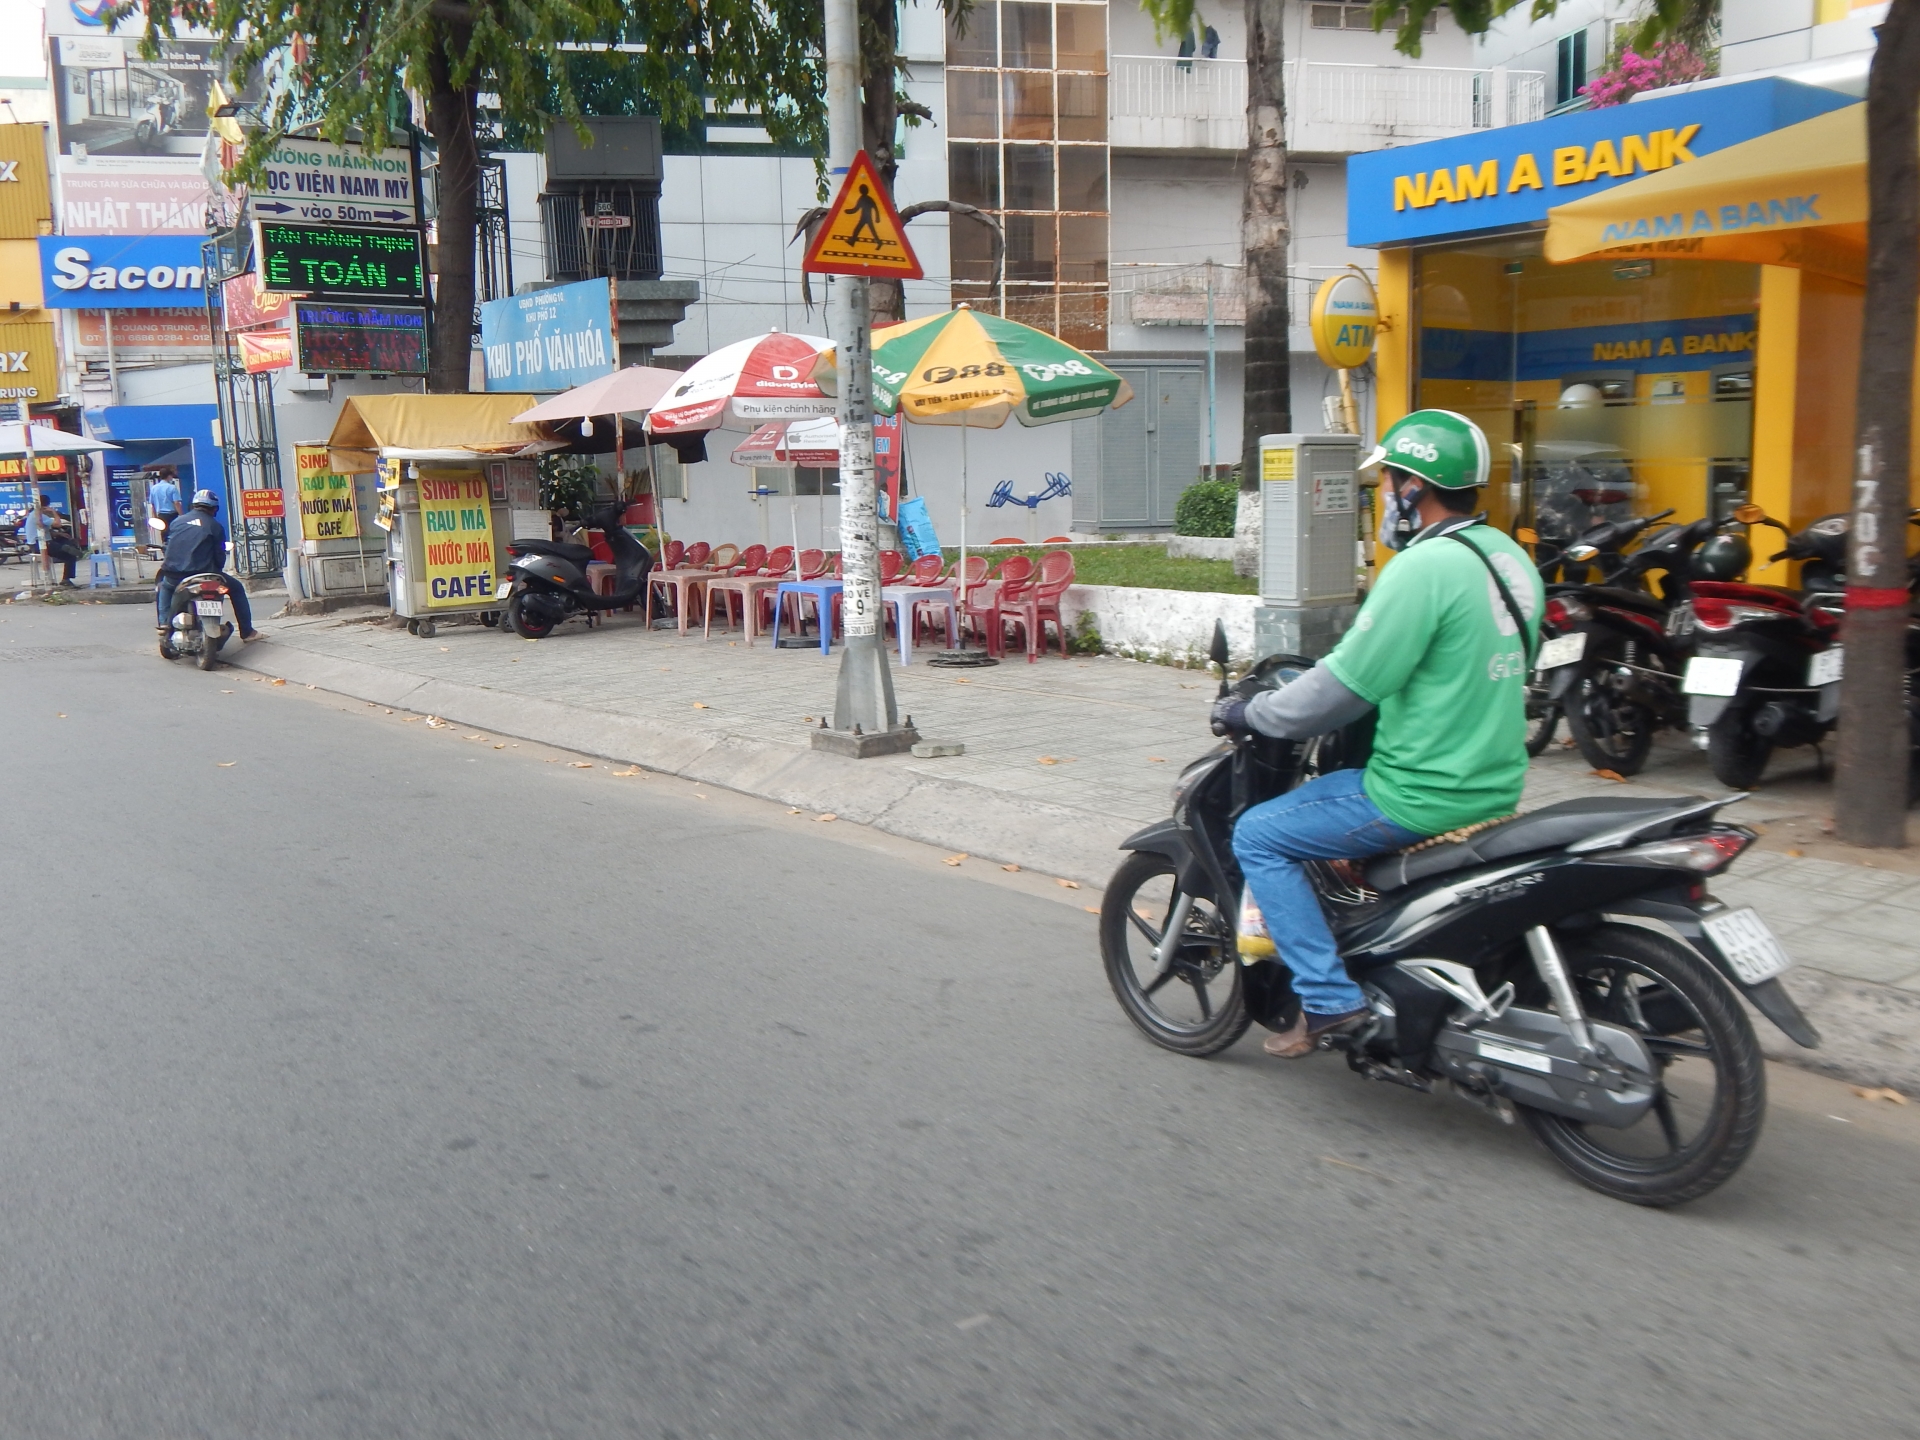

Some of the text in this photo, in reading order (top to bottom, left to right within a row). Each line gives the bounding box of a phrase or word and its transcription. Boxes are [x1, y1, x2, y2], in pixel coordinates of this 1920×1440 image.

[372, 159, 407, 174] NON
[1394, 124, 1703, 211] NAM A BANK
[66, 180, 98, 188] TRUNG
[99, 178, 119, 189] TÂM
[267, 170, 409, 199] ỌC VIỆN NAM MỸ
[300, 202, 372, 221] vào 50m
[1602, 194, 1822, 243] NAM A BANK
[266, 226, 415, 253] TÂN THÀNH THỊNH
[300, 307, 355, 325] TRƯỜNG
[394, 314, 423, 327] NON
[550, 307, 557, 319] 12
[122, 324, 158, 332] QUANG
[157, 334, 184, 342] 0284
[486, 318, 606, 380] KHU PHỐ VĂN HÓA
[1593, 331, 1758, 361] NAM A BANK
[923, 362, 1005, 384] F88
[743, 404, 761, 415] Phụ
[763, 404, 782, 415] kiện
[784, 403, 810, 413] chính
[1395, 437, 1439, 462] Grab
[300, 454, 328, 469] SINH
[303, 476, 325, 491] RAU
[422, 479, 460, 501] SINH
[303, 498, 330, 515] NƯỚC
[332, 496, 353, 513] MÍA
[317, 520, 343, 537] CAFÉ
[426, 510, 456, 532] RAU
[461, 505, 487, 531] MÁ
[428, 538, 491, 566] NƯỚC MÍA
[431, 571, 493, 599] CAFÉ
